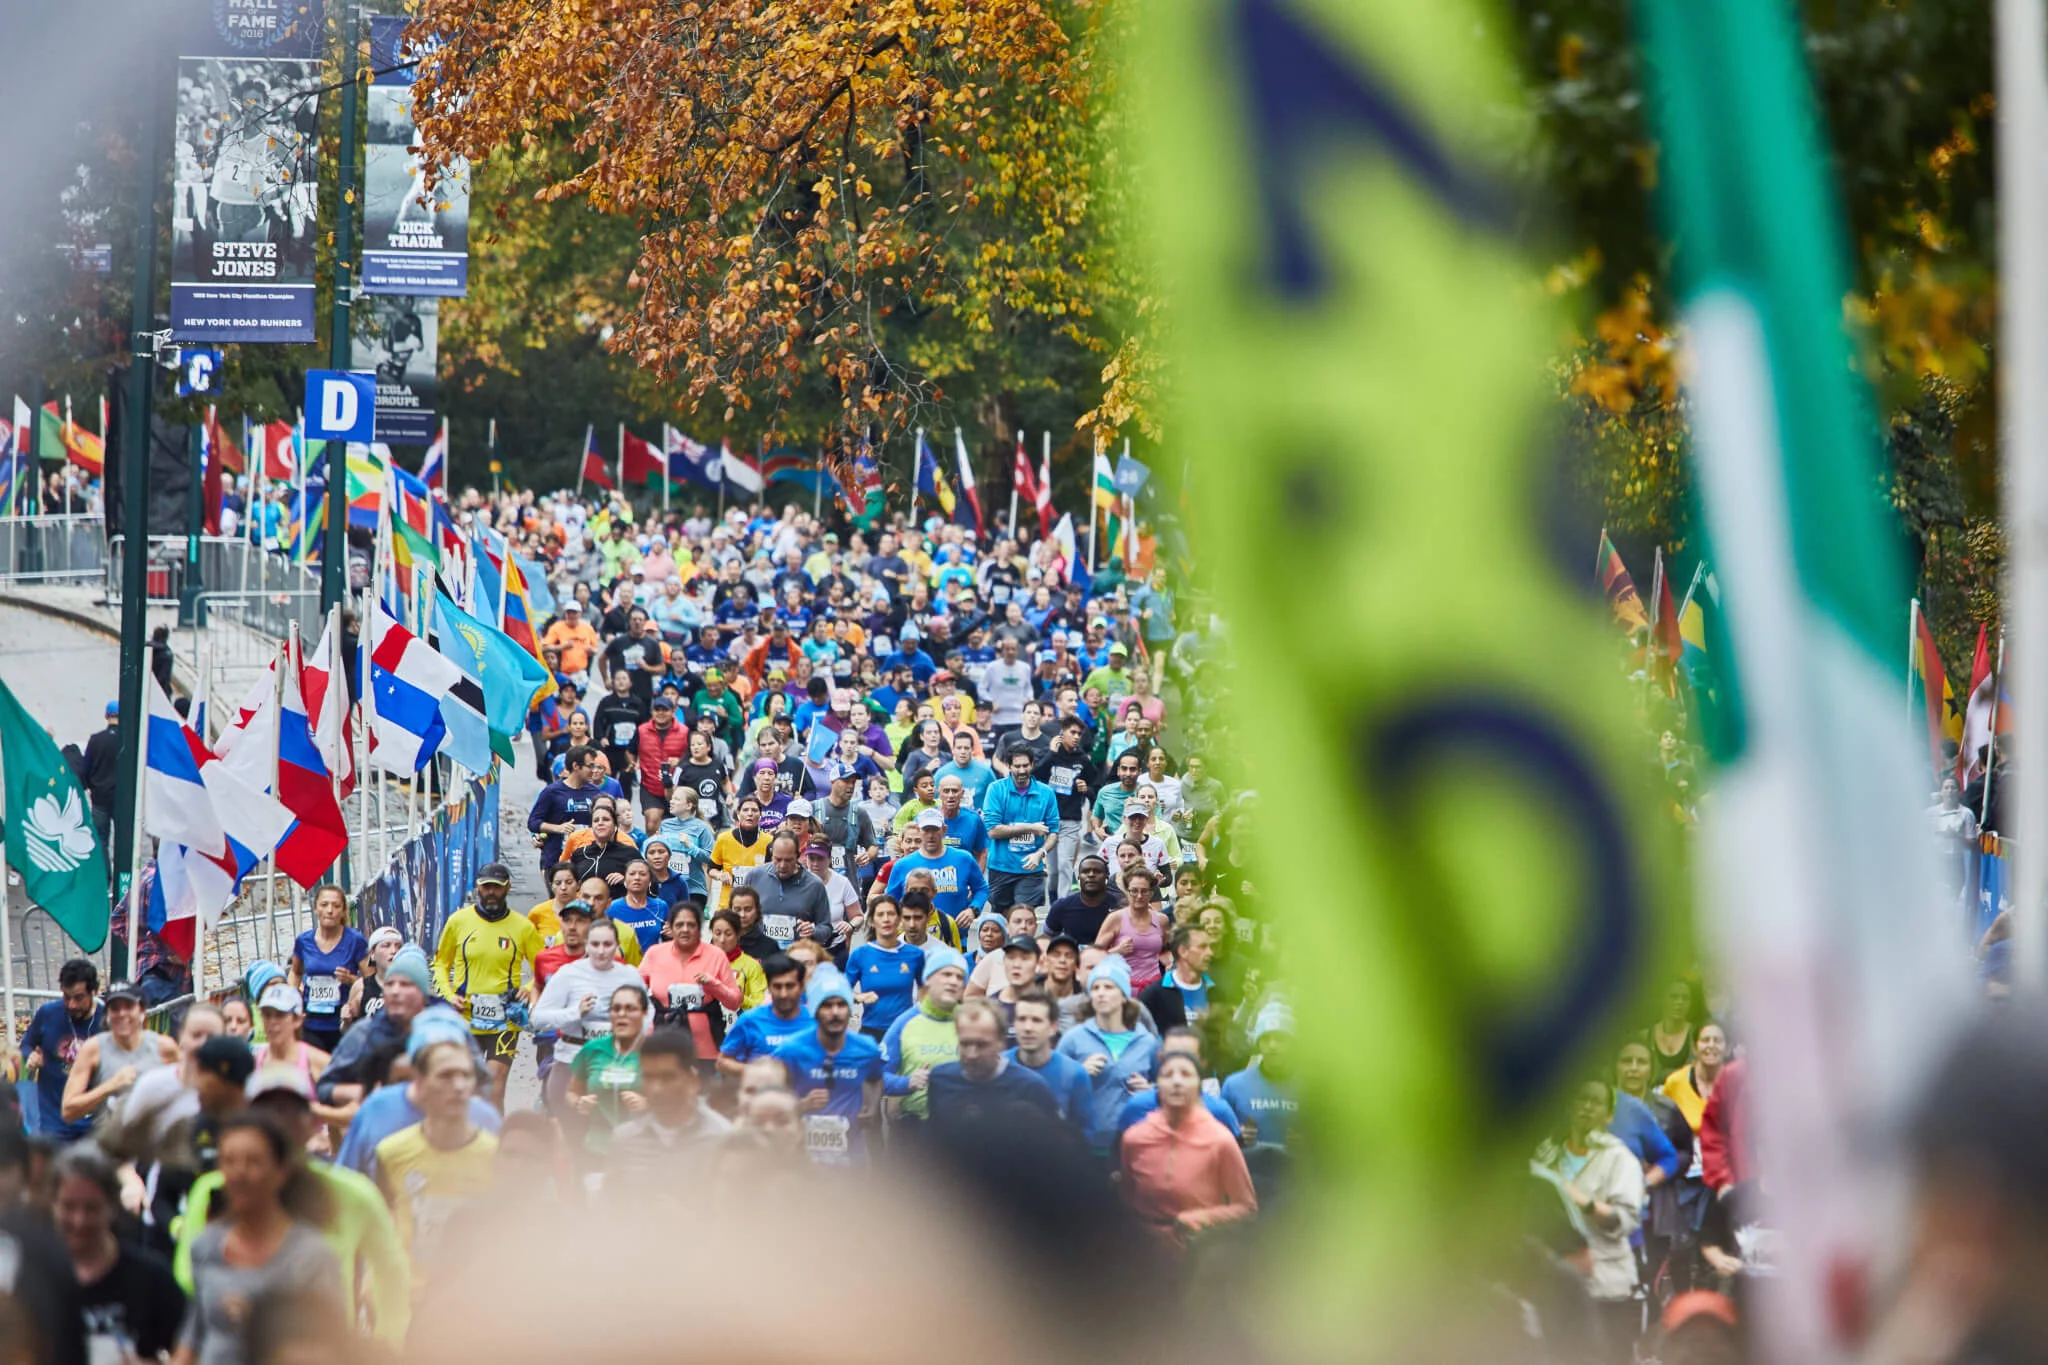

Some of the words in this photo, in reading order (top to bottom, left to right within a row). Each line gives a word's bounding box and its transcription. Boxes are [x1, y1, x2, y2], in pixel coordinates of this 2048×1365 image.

[229, 0, 277, 8] HALL
[228, 14, 277, 28] FAME
[399, 221, 434, 234] DICK
[388, 234, 443, 249] TRAUM
[212, 242, 277, 258] STEVE
[212, 260, 276, 277] JONES
[184, 318, 205, 326] NEW
[207, 318, 231, 327] YORK
[233, 319, 258, 327] ROAD
[261, 319, 302, 328] RUNNERS
[188, 354, 213, 391] C
[321, 379, 358, 431] D
[840, 1068, 858, 1079] TCS
[1250, 1098, 1279, 1110] TEAM
